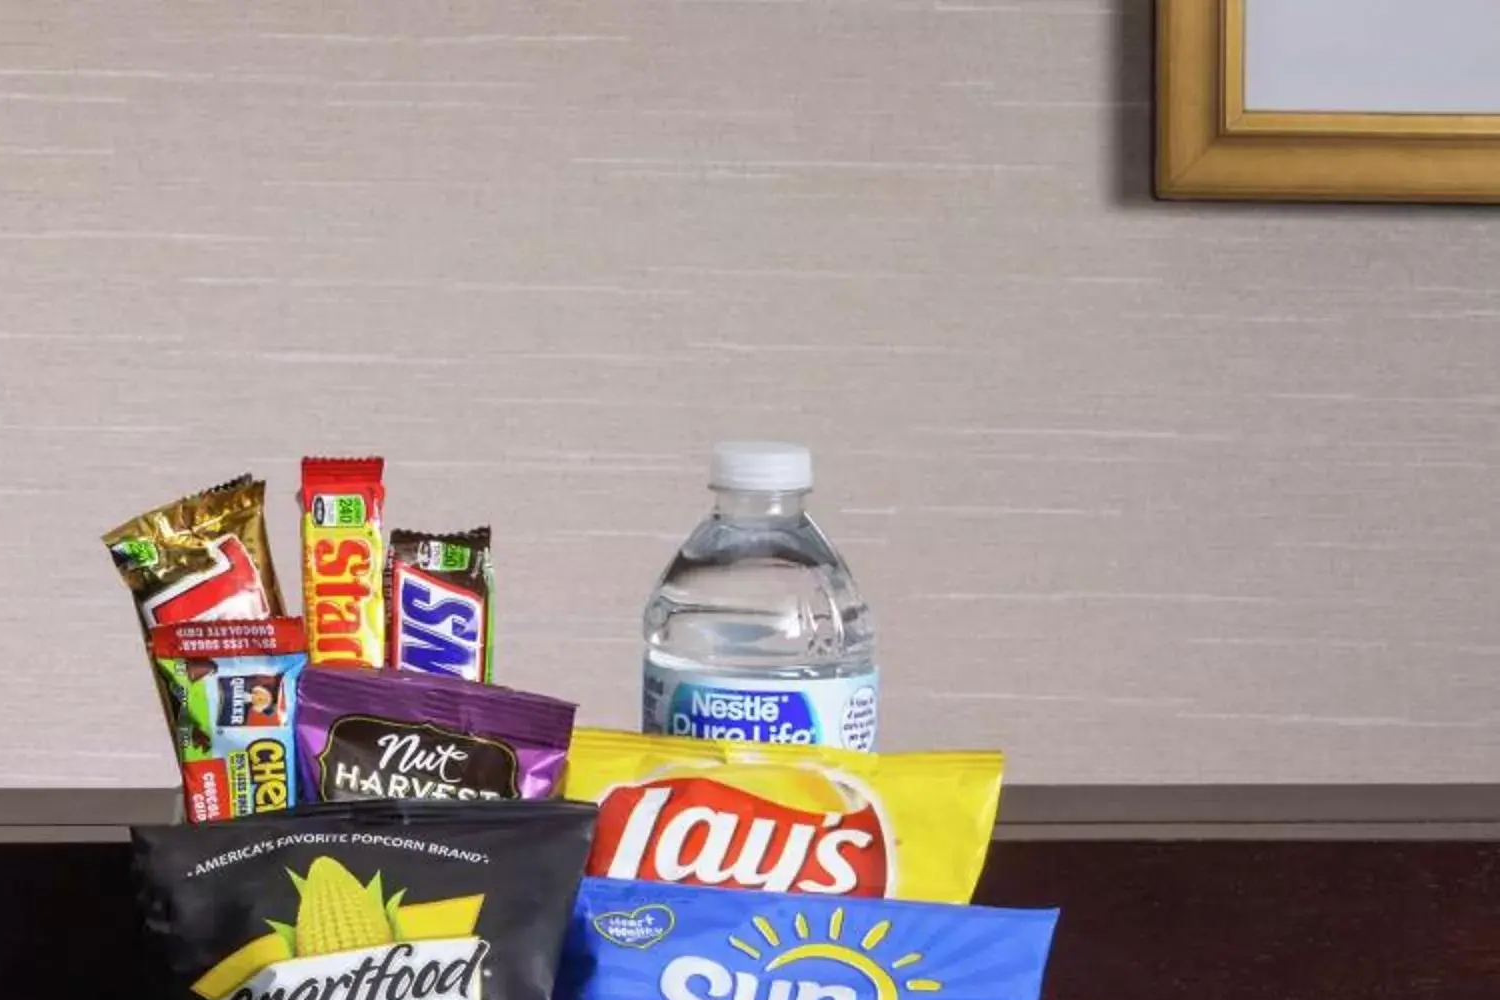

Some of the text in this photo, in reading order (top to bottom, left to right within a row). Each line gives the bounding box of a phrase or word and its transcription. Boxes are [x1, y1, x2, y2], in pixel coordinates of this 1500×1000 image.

[230, 677, 246, 724] QUAKER
[376, 734, 470, 784] Nut
[194, 840, 275, 876] AMERICA'S
[277, 832, 348, 848] FAVORITE
[351, 833, 426, 851] POPCORN
